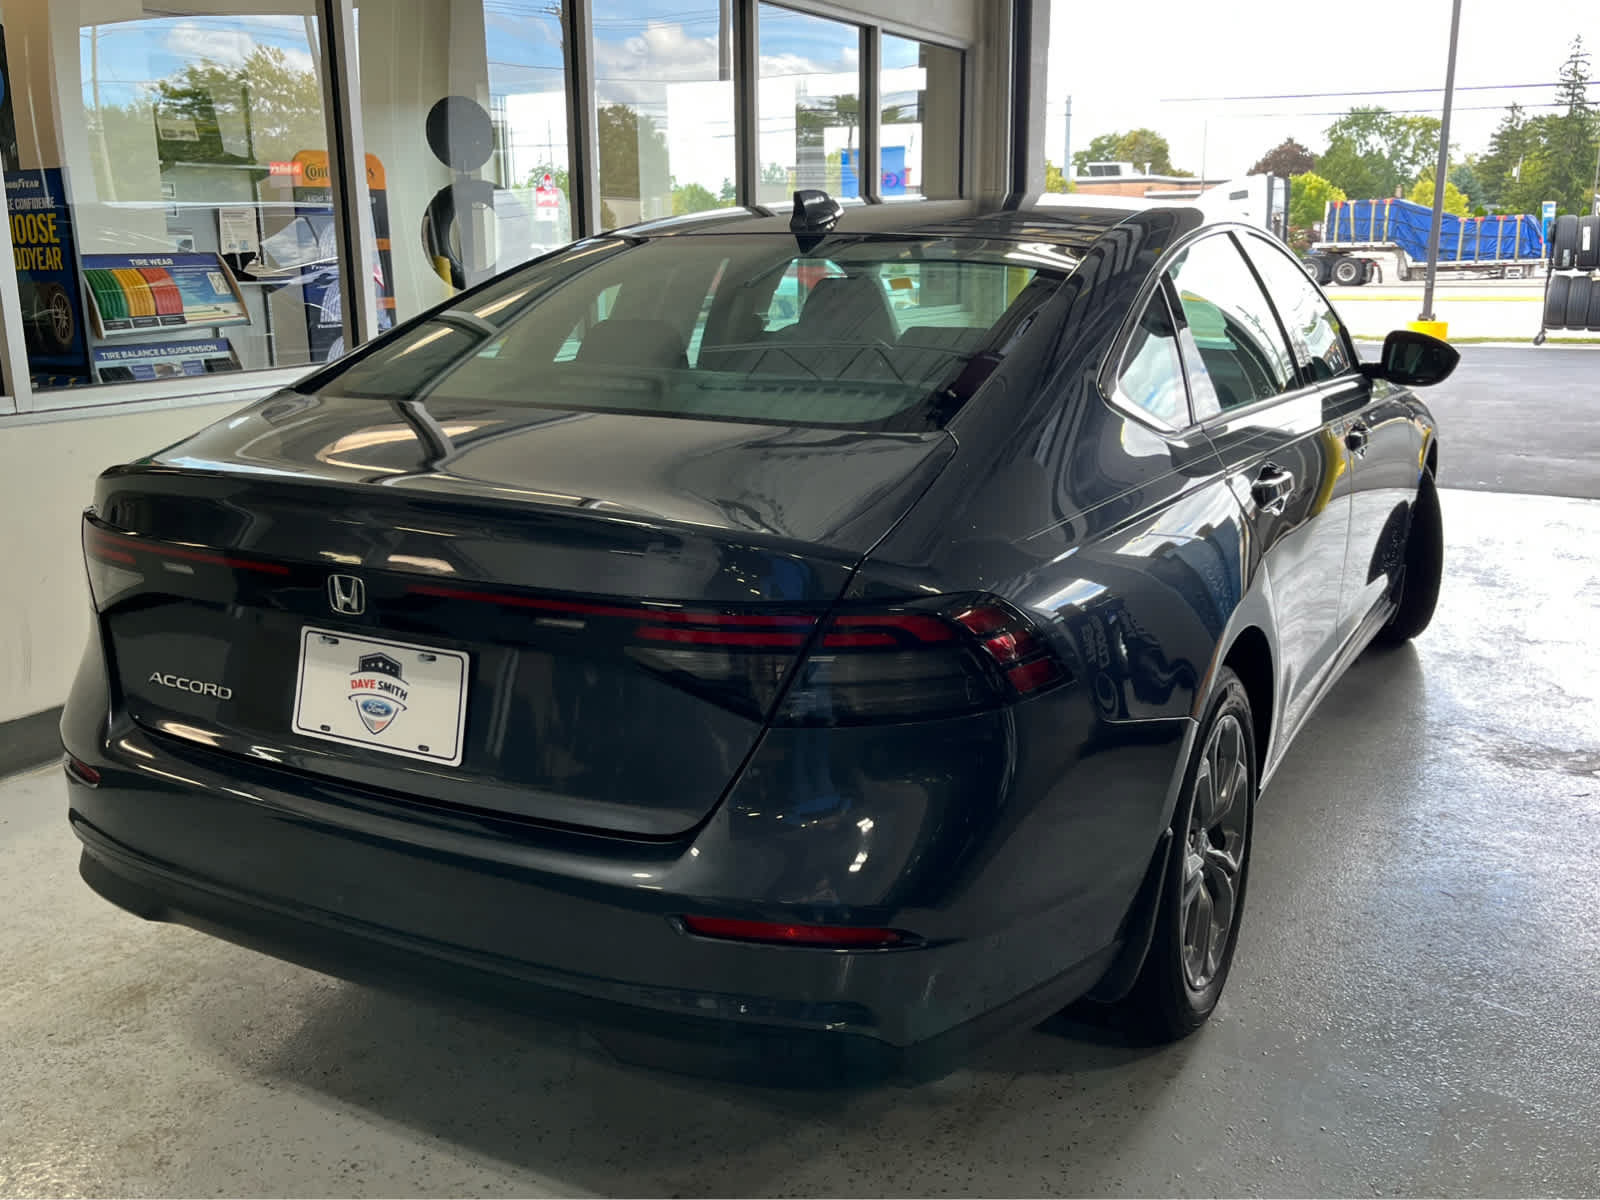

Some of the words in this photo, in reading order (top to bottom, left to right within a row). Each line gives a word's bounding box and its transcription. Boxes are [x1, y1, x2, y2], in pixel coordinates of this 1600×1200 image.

[128, 258, 149, 266] TIRE
[149, 258, 174, 266] WEAR
[102, 352, 121, 361] TIRE
[121, 348, 160, 358] BALANCE
[167, 344, 217, 355] SUSPENSION
[149, 671, 232, 701] ACCORD
[350, 679, 376, 690] DAVE
[377, 681, 408, 701] SMITH
